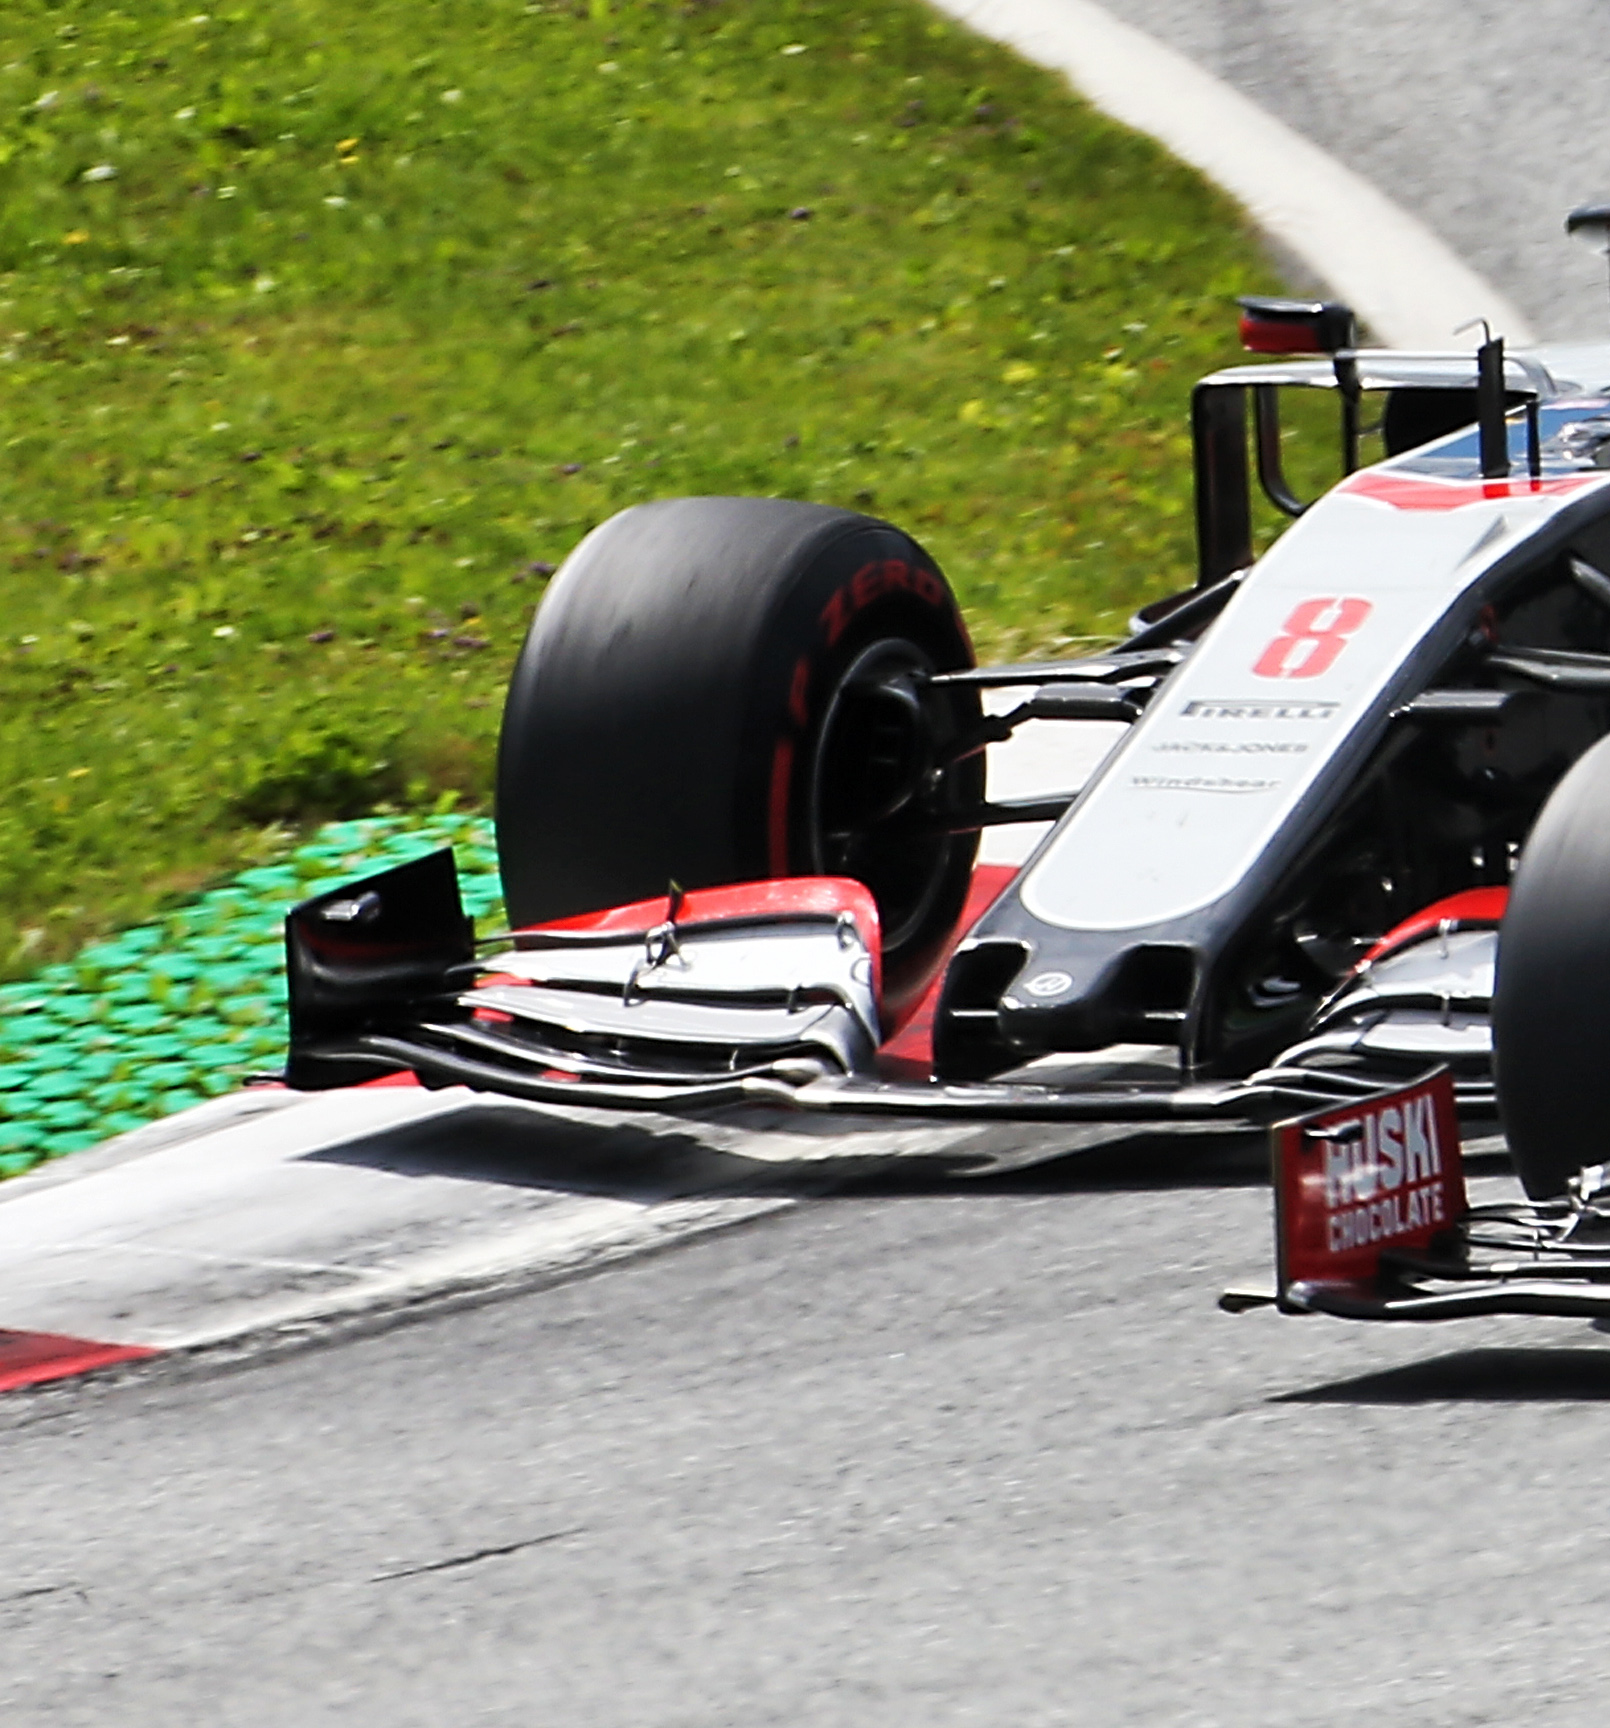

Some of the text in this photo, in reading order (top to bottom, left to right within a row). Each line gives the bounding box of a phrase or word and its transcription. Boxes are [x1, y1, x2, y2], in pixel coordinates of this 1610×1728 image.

[1251, 597, 1376, 680] 8
[1178, 698, 1342, 719] PIRELLI
[1324, 1093, 1441, 1209] HUSKI
[1328, 1182, 1445, 1253] CHOCOLATE
